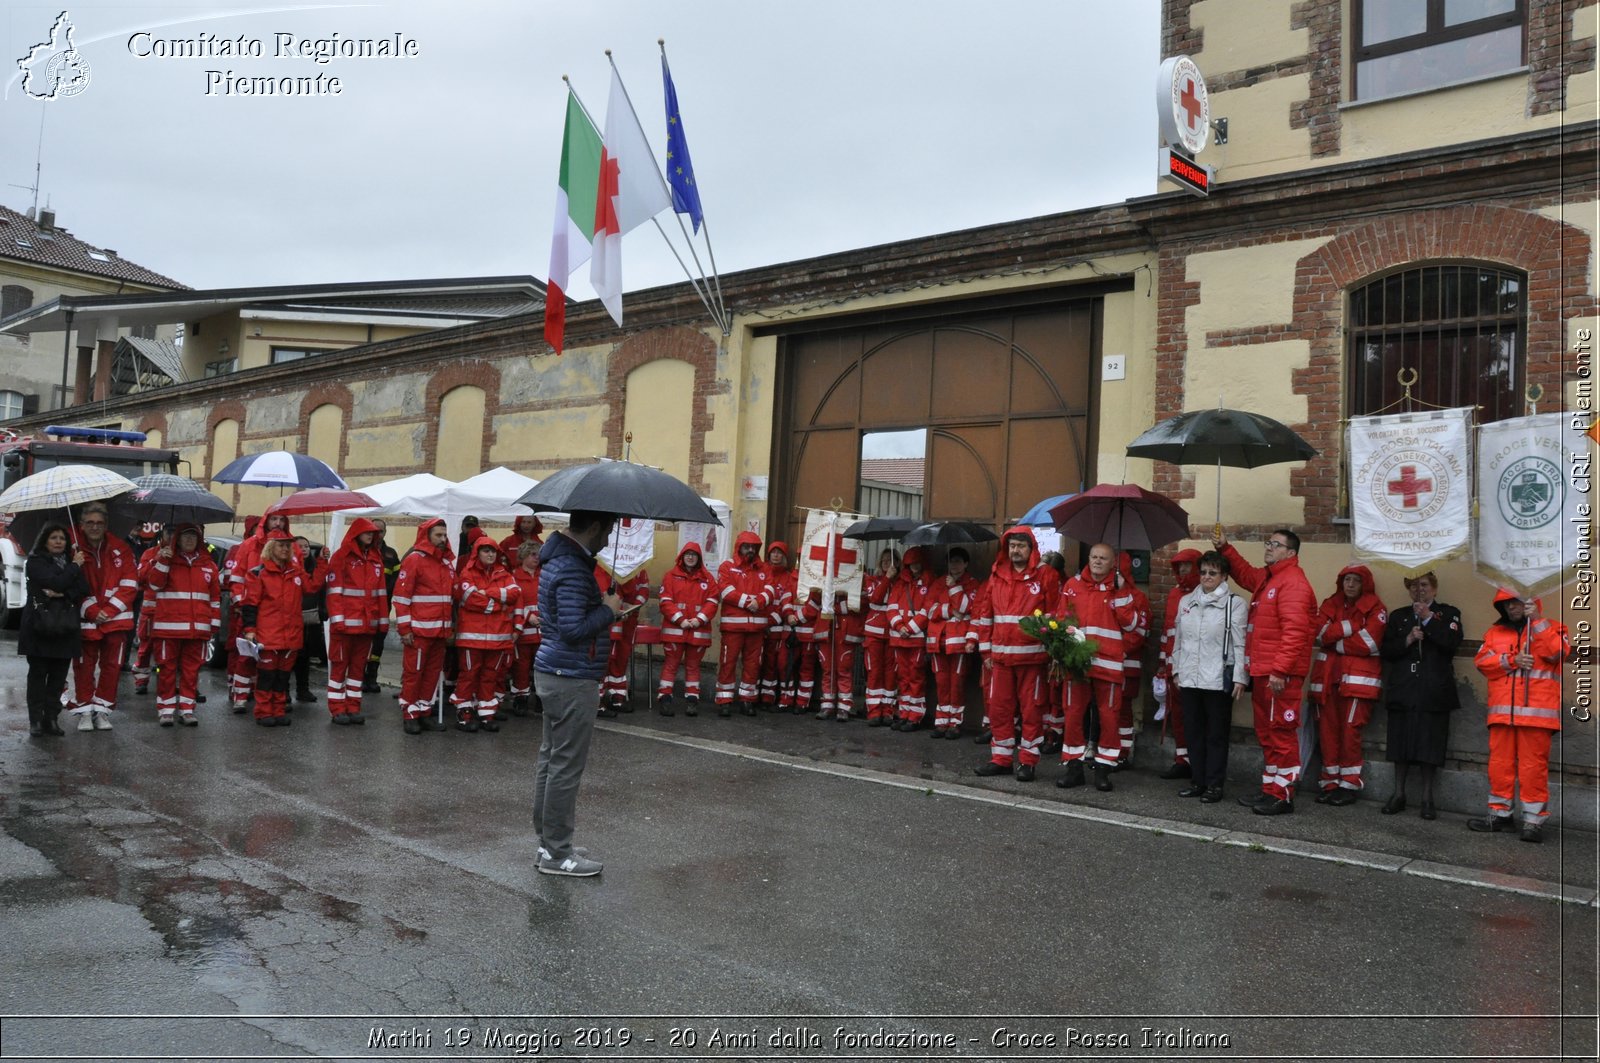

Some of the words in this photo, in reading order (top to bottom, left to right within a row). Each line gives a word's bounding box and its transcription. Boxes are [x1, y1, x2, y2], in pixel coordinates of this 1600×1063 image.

[1107, 362, 1119, 370] 92
[1489, 437, 1528, 470] CROCE
[1357, 450, 1382, 484] CROCE
[1381, 437, 1419, 455] ROSSA
[1423, 438, 1464, 477] ITALIANA
[1501, 462, 1527, 490] CROCE
[1536, 461, 1561, 488] VERDE
[1511, 513, 1550, 527] TORINO
[1371, 531, 1415, 541] COMITATO
[1417, 529, 1453, 539] LOCALE
[1393, 541, 1432, 552] FIANO
[1505, 540, 1544, 549] SEZIONE
